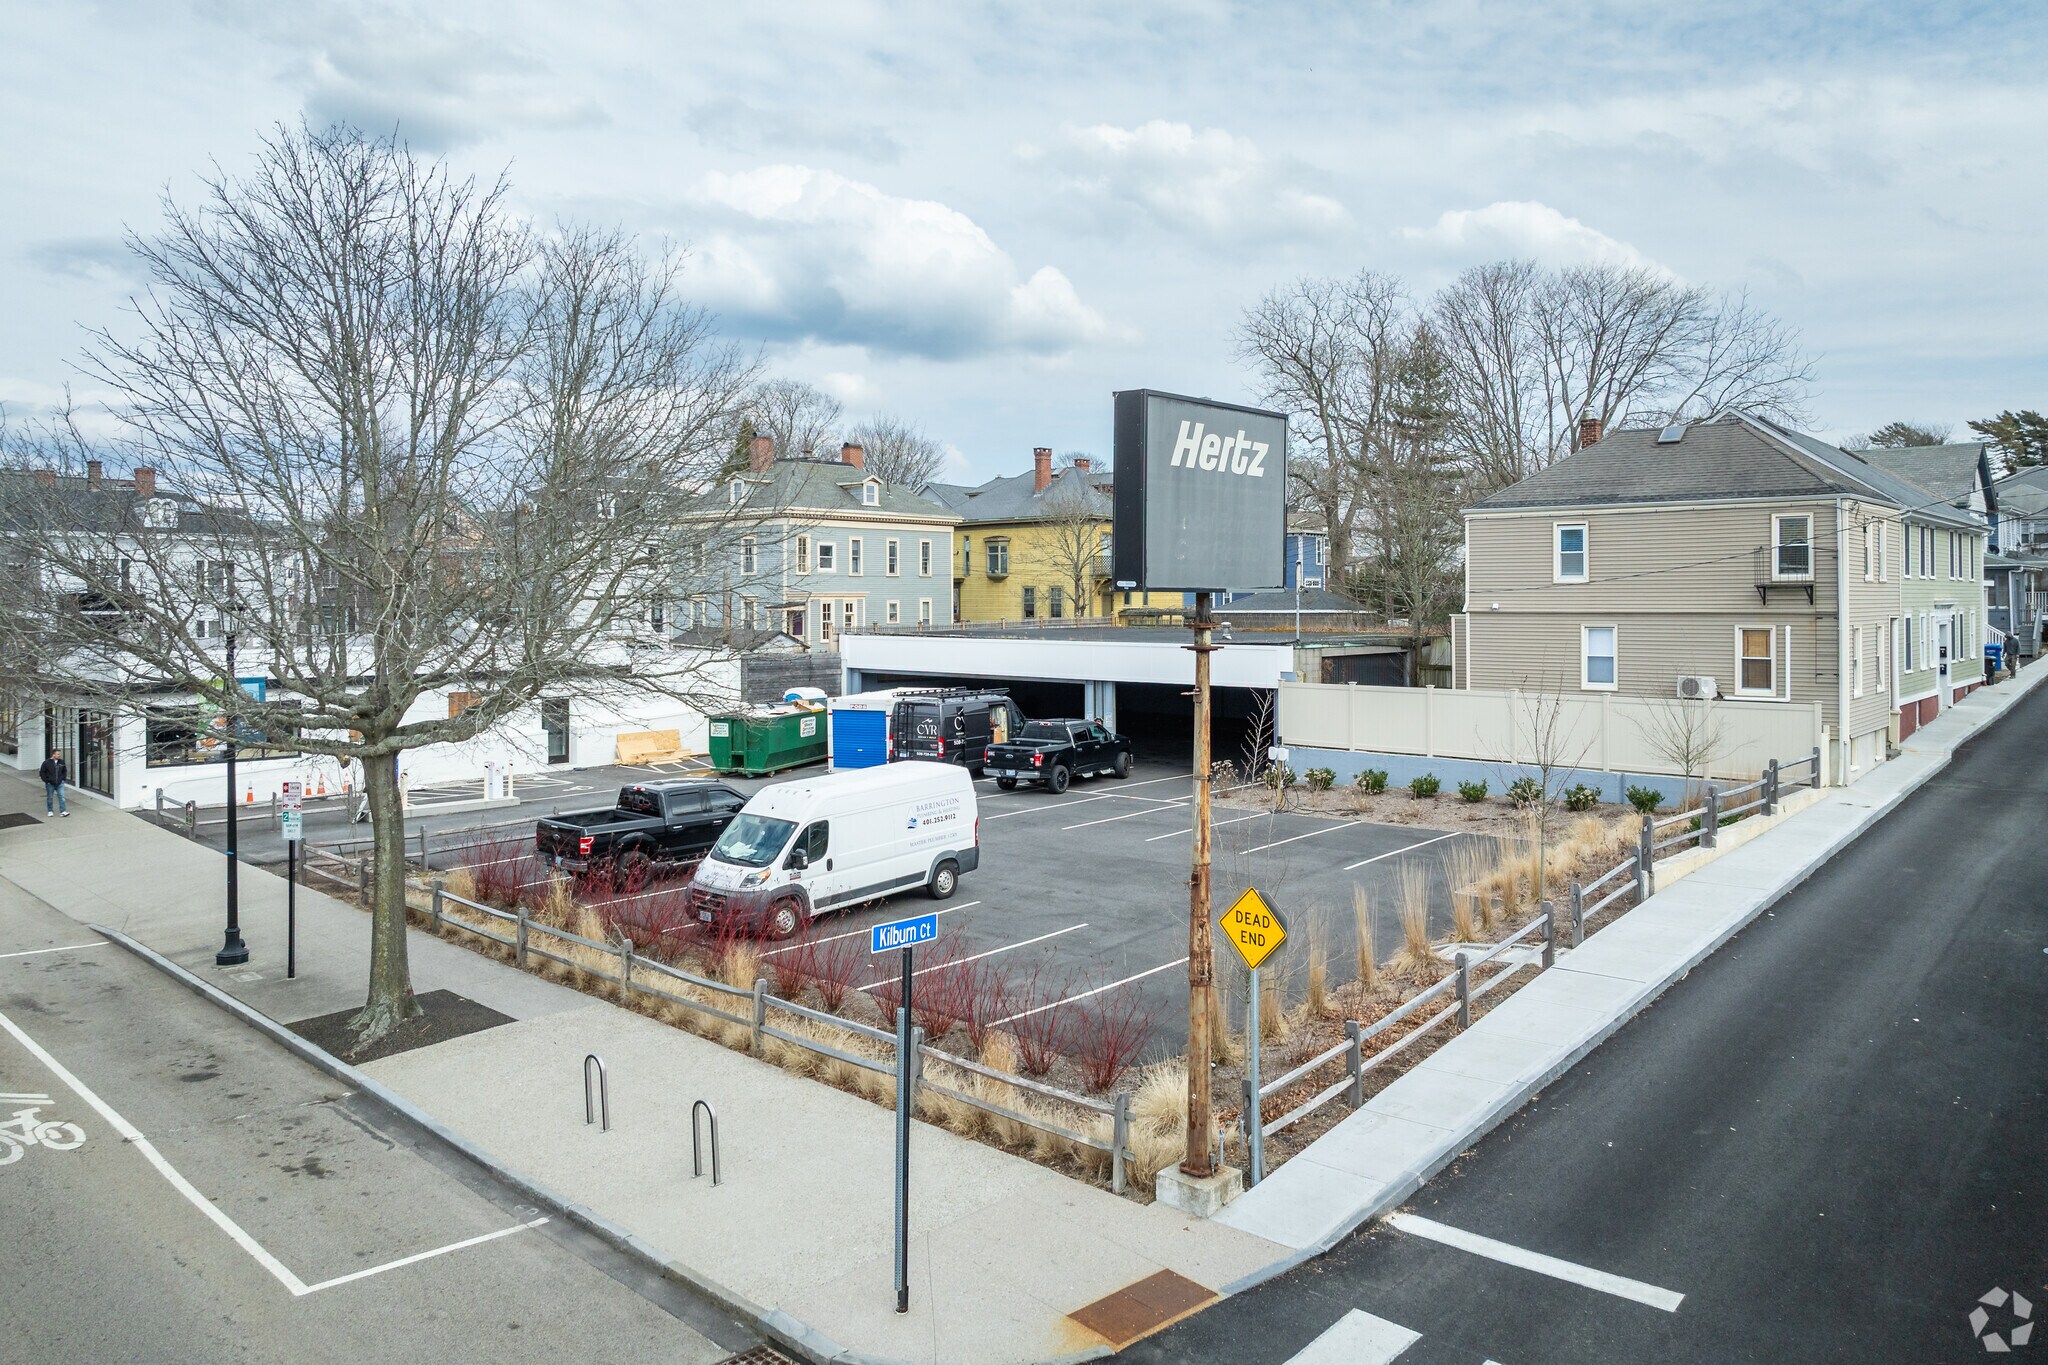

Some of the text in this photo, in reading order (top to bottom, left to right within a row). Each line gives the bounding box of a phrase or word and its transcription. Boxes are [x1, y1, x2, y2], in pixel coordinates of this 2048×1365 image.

[1170, 420, 1270, 478] Hertz
[916, 723, 937, 736] CYR
[916, 797, 960, 812] BARRINGTON
[922, 813, 956, 826] 401.252.9112
[1235, 910, 1270, 929] DEAD
[879, 922, 931, 948] Kilburn Ct
[1241, 930, 1266, 947] END
